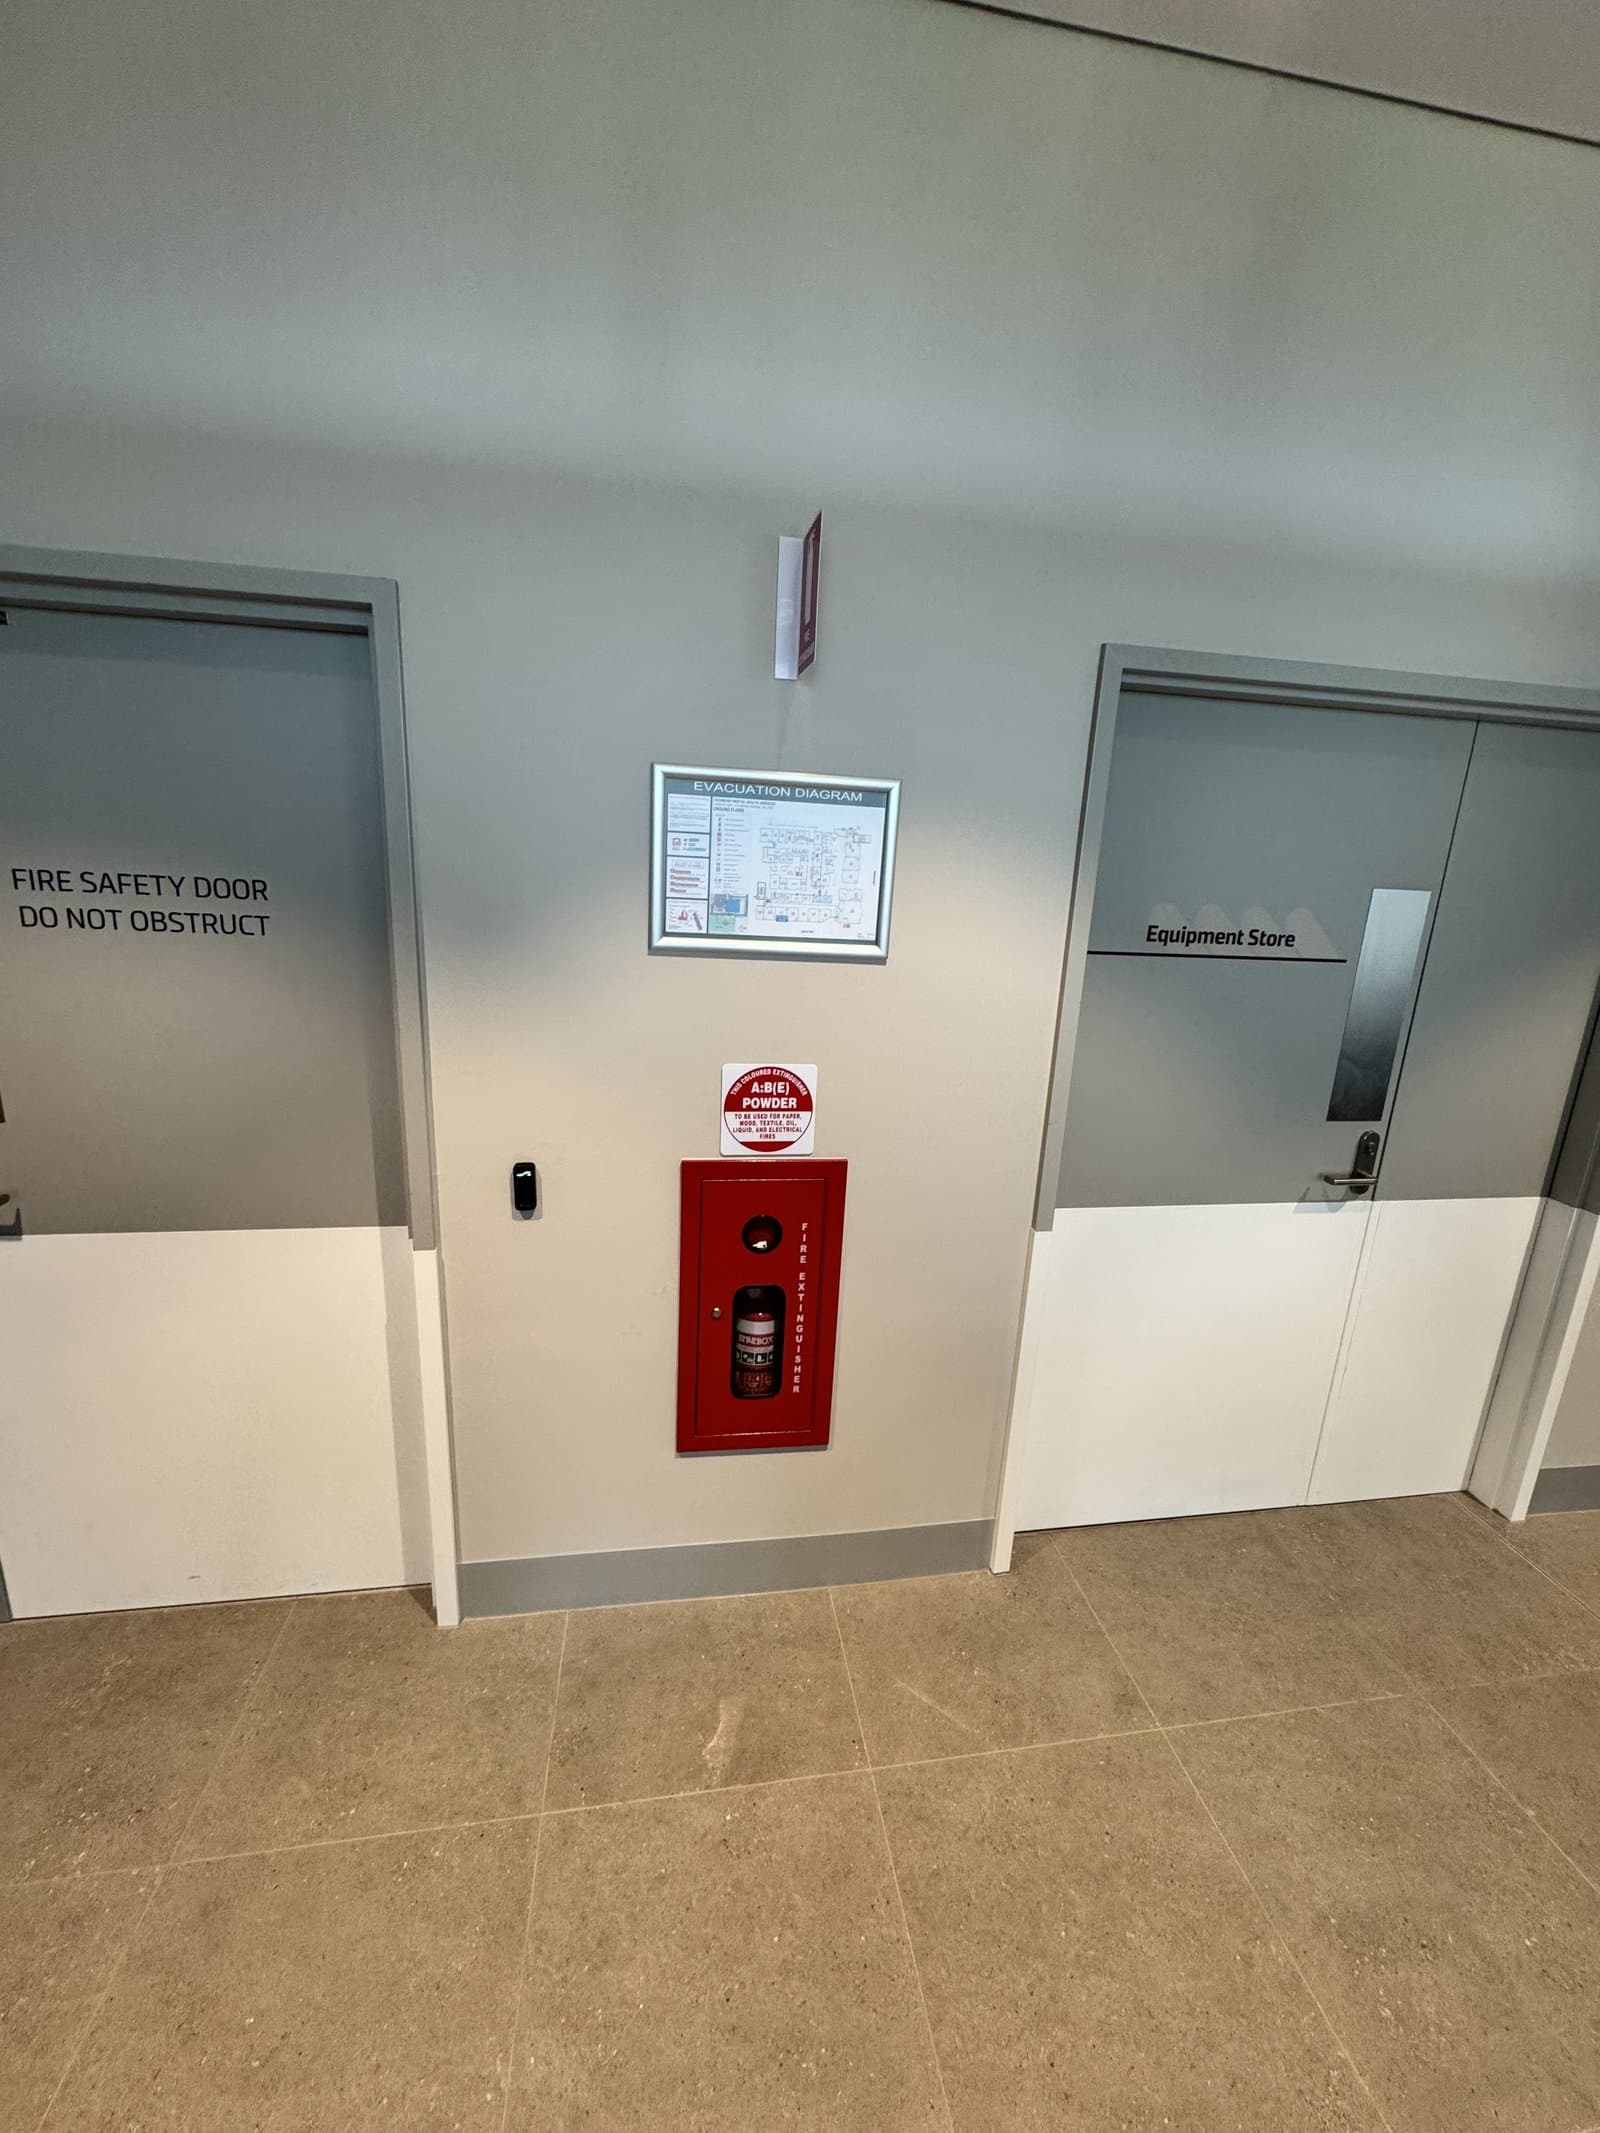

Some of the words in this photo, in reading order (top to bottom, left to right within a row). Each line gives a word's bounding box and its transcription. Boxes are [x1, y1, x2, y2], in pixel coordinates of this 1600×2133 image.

[694, 781, 790, 798] EVACUATION
[795, 787, 863, 802] DIAGRAM
[11, 868, 73, 893] FIRE
[79, 871, 186, 897] SAFETY
[194, 876, 269, 900] DOOR
[19, 905, 58, 928] DO
[66, 907, 122, 931] NOT
[130, 910, 270, 936] OBSTRUCT
[1146, 924, 1244, 947] Equipment
[1248, 929, 1296, 947] Store
[730, 1083, 743, 1095] THIS
[740, 1068, 772, 1084] COLOURED
[772, 1068, 808, 1097] EXTINGUISHER
[751, 1081, 790, 1096] A:B(E)
[742, 1097, 797, 1109] POWDER
[800, 1222, 808, 1264] FIRE
[792, 1272, 806, 1393] EXTINGUISHER
